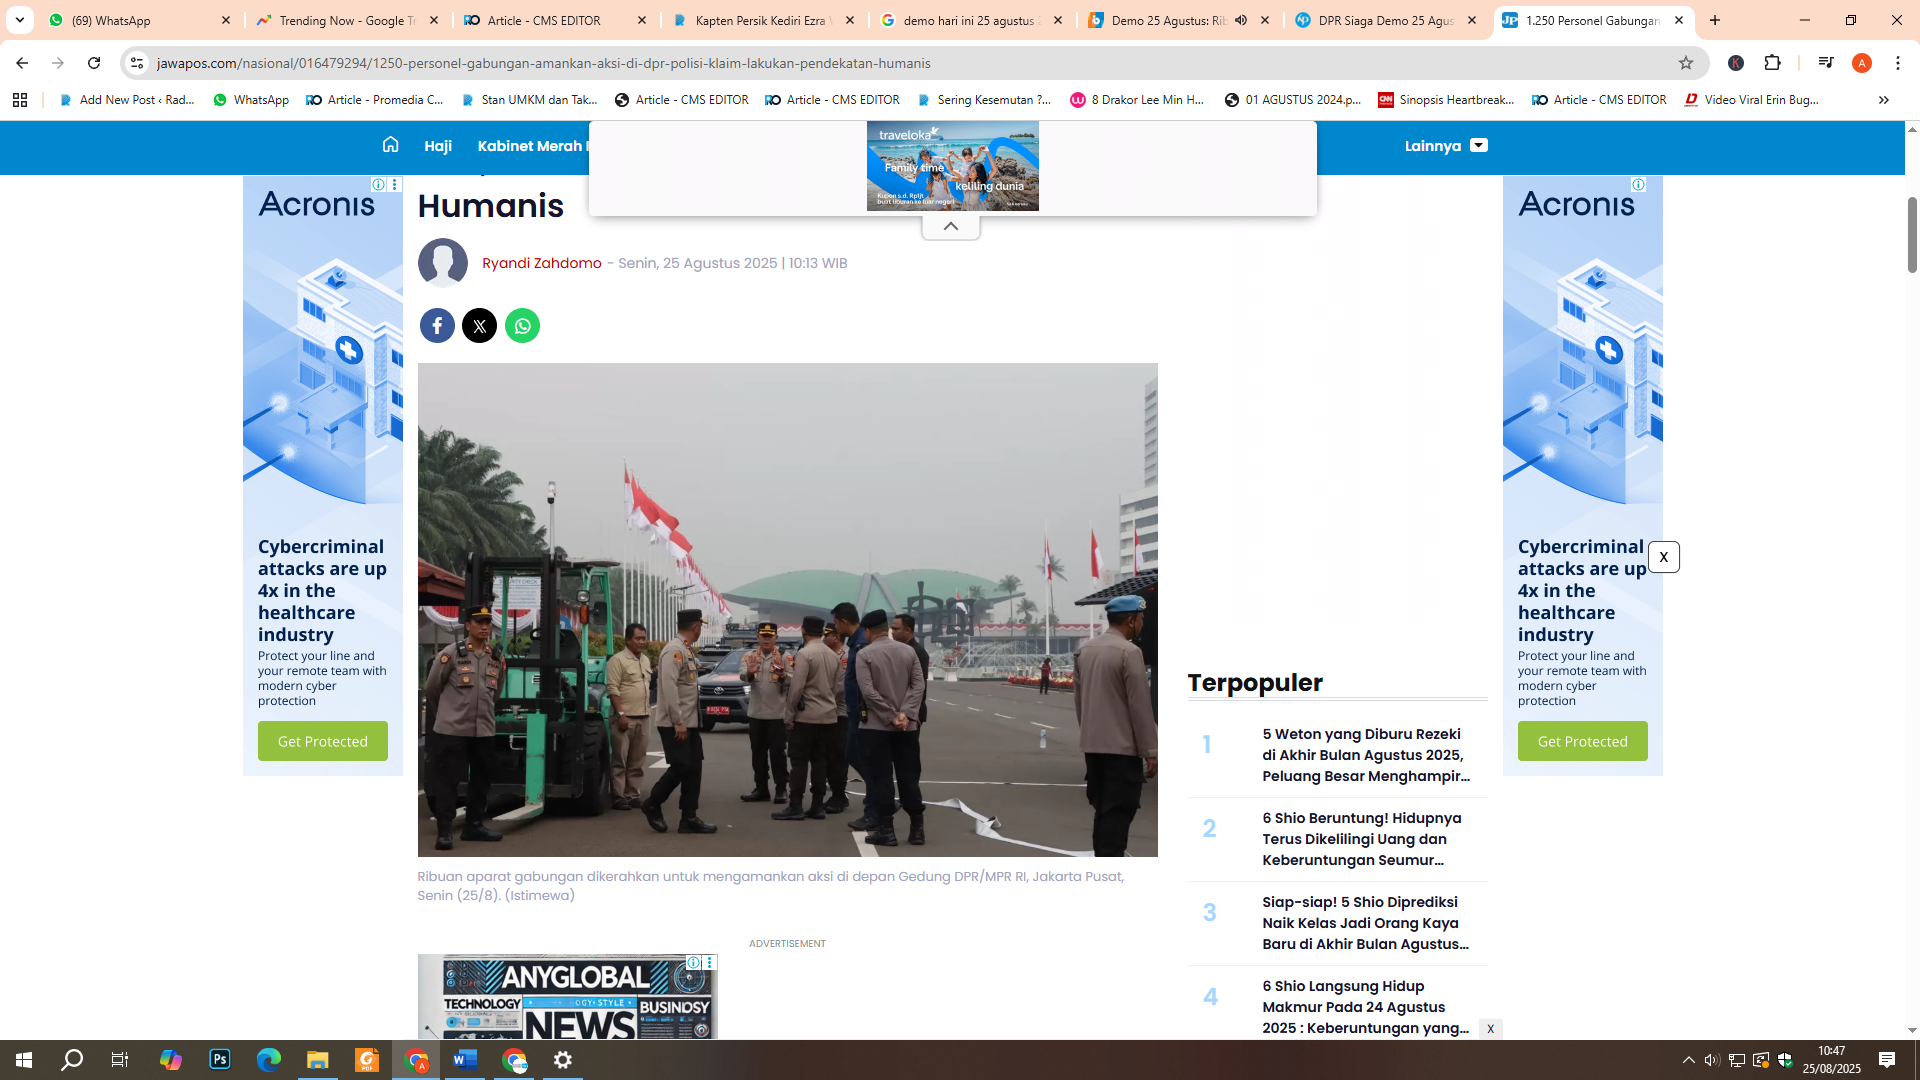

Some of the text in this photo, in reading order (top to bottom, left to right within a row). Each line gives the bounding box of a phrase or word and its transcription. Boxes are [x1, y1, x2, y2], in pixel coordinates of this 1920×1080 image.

[73, 16, 150, 28] (69) WhatsApp
[280, 16, 326, 28] Trending
[330, 16, 354, 25] Now
[366, 16, 404, 28] Google
[697, 16, 825, 28] Kapten Persik Kediri Ezra
[904, 16, 1034, 28] demo hari ini 25 agustus
[1113, 16, 1144, 25] Demo
[1148, 16, 1160, 25] 25
[1163, 16, 1208, 28] Agustus:
[1320, 16, 1342, 25] DPR
[1345, 16, 1373, 28] Siaga
[1377, 16, 1408, 25] Demo
[1412, 16, 1424, 25] 25
[1527, 16, 1660, 28] 1.250 Personel Gabungan
[157, 58, 931, 71] jawapos.com/nasional/016479294/1250-personel-gabungan-amankan-aksi-di-dpr-polisi-klaim-lakukan-pendekatan-humanis
[234, 95, 289, 107] WhatsApp
[482, 95, 597, 104] Stan UMKM dan Tak...
[938, 95, 971, 107] Sering
[975, 95, 1033, 104] Kesemutan
[1092, 95, 1203, 104] 8 Drakor Lee Min H...
[1400, 95, 1514, 107] Sinopsis Heartbreak...
[1705, 95, 1818, 107] Video Viral Erin Bug...
[879, 130, 932, 141] traveloka
[425, 140, 452, 155] Haji
[479, 140, 582, 151] Kabinet Merah
[1406, 140, 1461, 155] Lainnya
[885, 163, 945, 174] Family time
[955, 181, 1025, 193] keliling dunia
[258, 191, 375, 216] Acronis
[419, 192, 563, 217] Humanis
[1518, 191, 1635, 216] Acronis
[483, 257, 601, 272] Ryandi Zahdomo
[619, 257, 659, 270] Senin,
[663, 258, 680, 268] 25
[684, 258, 740, 272] Agustus
[744, 258, 777, 268] 2025
[789, 258, 818, 268] 10:13
[822, 258, 847, 268] WIB
[259, 539, 383, 558] Cybercriminal
[259, 561, 386, 580] attacks are up
[258, 583, 335, 597] 4x in the
[259, 605, 355, 619] healthcare
[259, 627, 334, 646] industry
[259, 651, 374, 663] Protect your line and
[258, 666, 386, 678] your remote team with
[259, 681, 336, 693] modern cyber
[1188, 673, 1323, 697] Terpopuler
[259, 696, 315, 708] protection
[279, 736, 367, 747] Get Protected
[1263, 728, 1461, 743] 5 Weton yang Diburu Rezeki
[1539, 736, 1627, 747] Get Protected
[1203, 735, 1210, 753] 1
[1263, 749, 1463, 764] di Akhir Bulan Agustus 2025,
[1263, 770, 1470, 785] Peluang Besar Menghampir...
[1263, 812, 1461, 827] 6 Shio Beruntung! Hidupnya
[1204, 819, 1216, 837] 2
[418, 869, 1124, 885] Ribuan aparat gabungan dikerahkan untuk mengamankan aksi di depan Gedung DPR/MPR RI, Jakarta Pusat,
[418, 888, 574, 903] Senin (25/8). (Istimewa)
[502, 965, 650, 989] ANYGLOBAL
[1263, 980, 1425, 995] 6 Shio Langsung Hidup
[444, 998, 521, 1010] TECHNOLOGY
[598, 999, 624, 1007] STYLE
[525, 1011, 636, 1039] NEWS
[1819, 1046, 1845, 1055] 10:47
[1803, 1064, 1861, 1074] 25/08/2025
